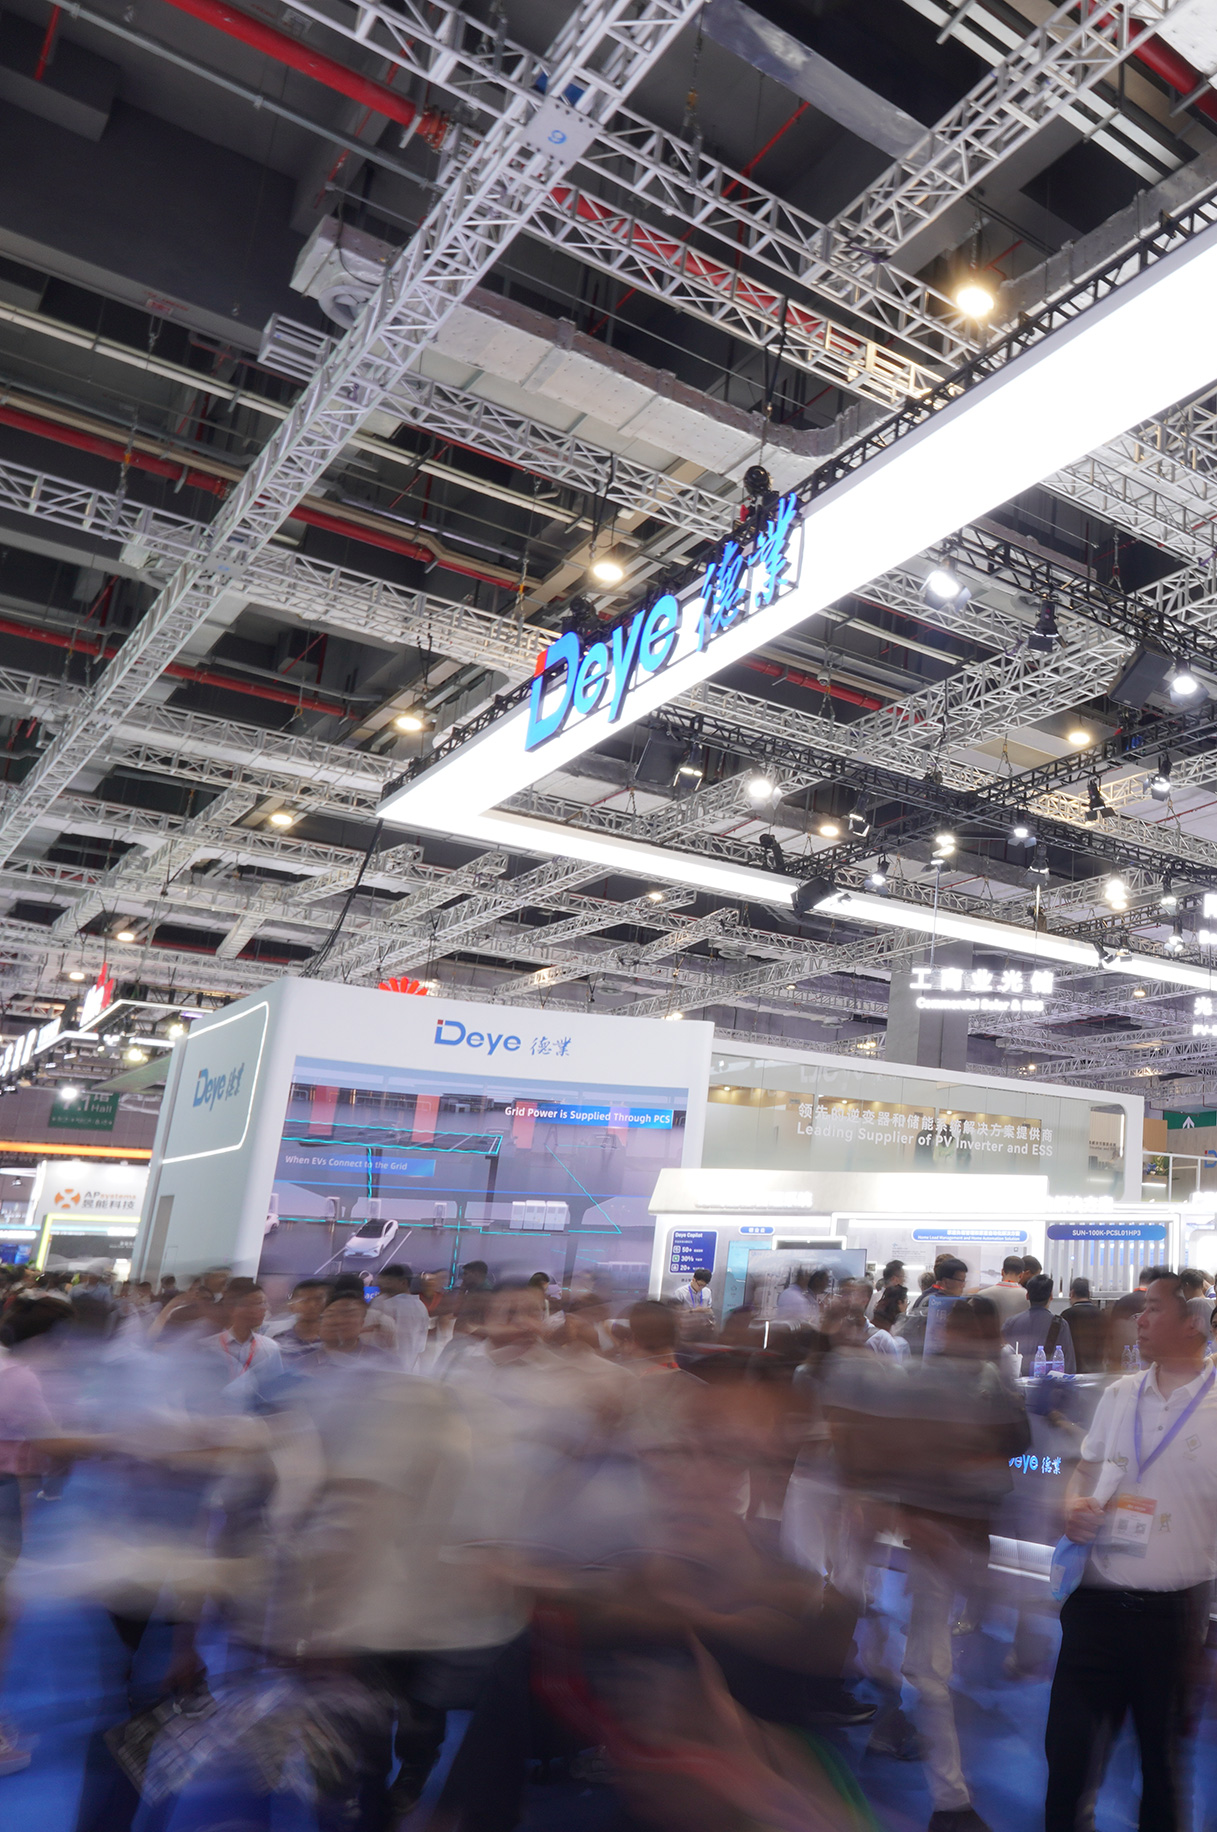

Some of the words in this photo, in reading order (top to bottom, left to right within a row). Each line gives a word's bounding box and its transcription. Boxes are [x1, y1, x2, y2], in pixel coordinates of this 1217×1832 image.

[525, 594, 680, 752] Deye
[434, 1019, 521, 1056] Deye
[193, 1068, 226, 1112] Deye
[91, 1104, 112, 1113] Hall
[504, 1106, 525, 1117] Grid
[527, 1108, 557, 1119] Power
[559, 1109, 567, 1119] is
[570, 1110, 611, 1122] Supplied
[613, 1112, 651, 1125] Through
[653, 1114, 670, 1124] PCS
[798, 1103, 1053, 1142] 领先的逆变器和储能系统解决方案提供商
[797, 1121, 852, 1142] Leading
[857, 1127, 914, 1147] Supplier
[917, 1133, 931, 1147] of
[935, 1134, 952, 1148] PV
[956, 1136, 1004, 1153] Inverter
[1007, 1142, 1028, 1155] and
[1032, 1144, 1054, 1157] ESS
[285, 1155, 310, 1164] When
[311, 1157, 326, 1166] EVs
[328, 1158, 362, 1168] Connect
[374, 1161, 388, 1169] the
[390, 1162, 408, 1171] Grid
[85, 1191, 137, 1199] APsystems
